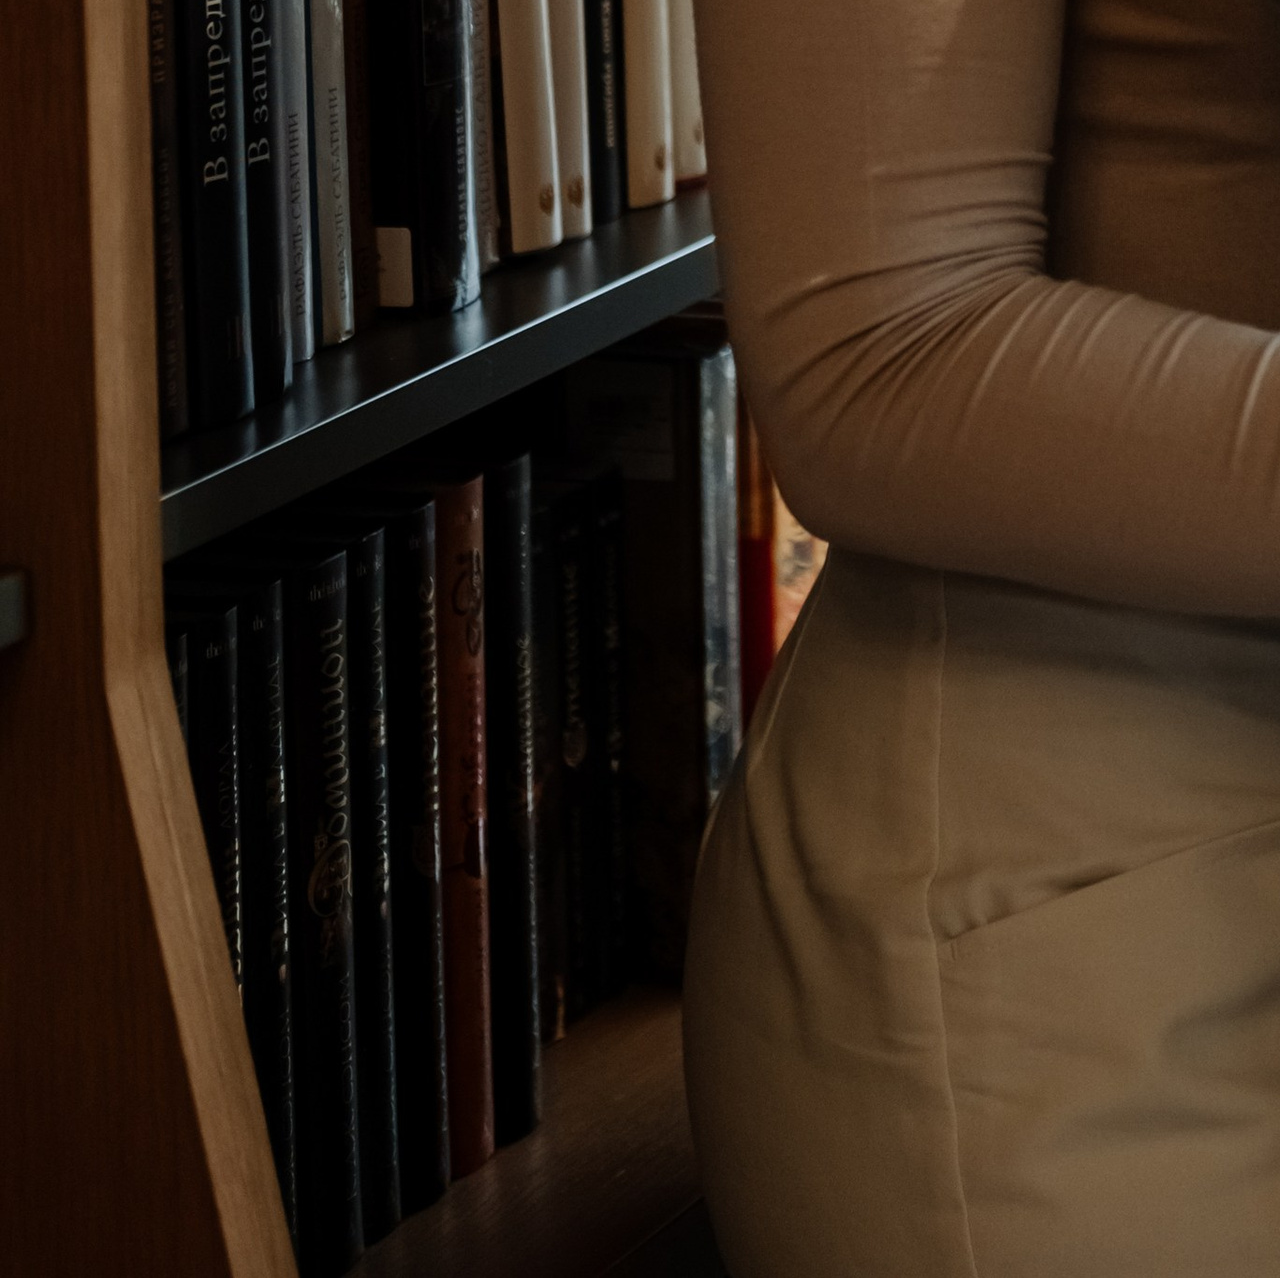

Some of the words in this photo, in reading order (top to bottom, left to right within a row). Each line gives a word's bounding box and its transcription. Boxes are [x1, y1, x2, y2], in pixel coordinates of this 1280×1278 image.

[203, 154, 230, 185] В
[245, 136, 272, 165] В
[286, 112, 303, 221] САБАТИНИ
[326, 86, 341, 199] САБАТИНИ
